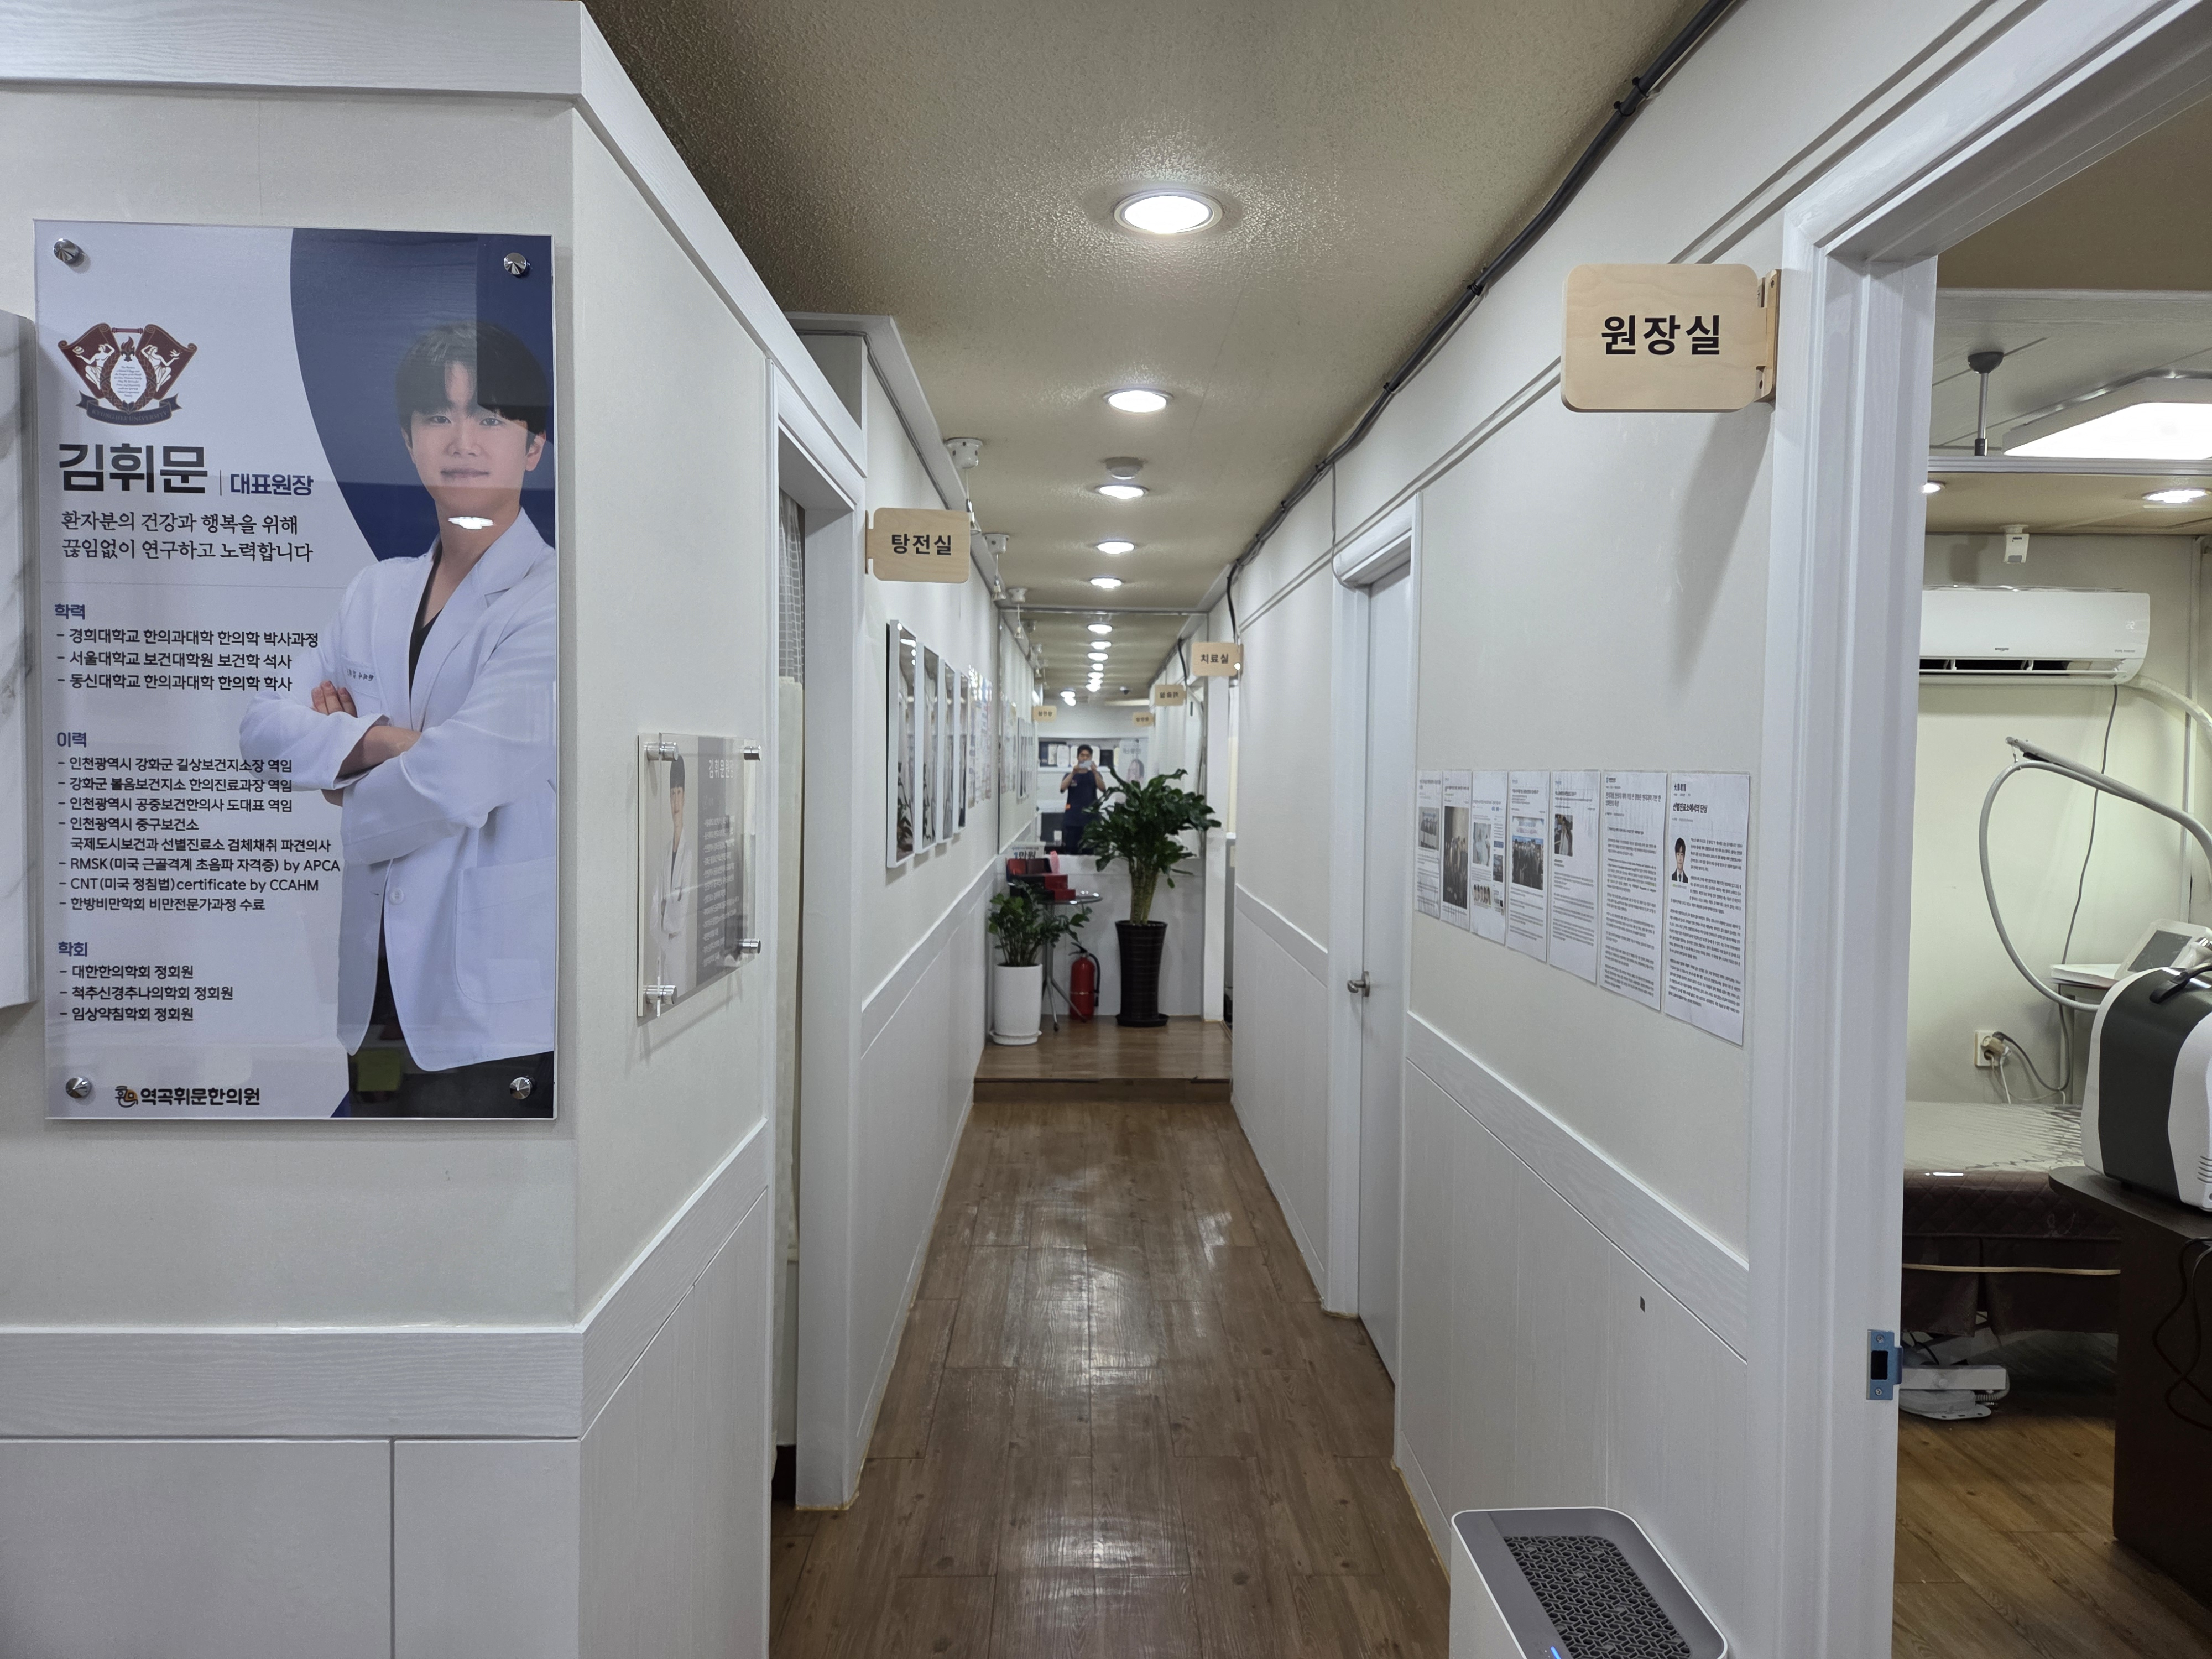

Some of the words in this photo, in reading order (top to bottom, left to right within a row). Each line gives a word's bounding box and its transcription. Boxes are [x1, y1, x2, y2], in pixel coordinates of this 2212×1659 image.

[1601, 315, 1719, 355] 원장실
[59, 443, 207, 493] 김휘문
[231, 474, 314, 495] 대표원장
[61, 510, 134, 531] 환자분의
[142, 513, 197, 533] 건강과
[201, 514, 257, 534] 행복을
[262, 515, 297, 535] 위해
[62, 539, 134, 559] 끊임없이
[142, 540, 216, 560] 연구하고
[220, 542, 313, 562] 노력합니다
[892, 534, 951, 555] 탕전실
[55, 604, 85, 620] 학력
[70, 629, 140, 644] 경희대학교
[143, 629, 214, 645] 한의과대학
[217, 630, 260, 646] 한의학
[264, 632, 317, 648] 박사과정
[70, 651, 140, 666] 서울대학교
[144, 653, 213, 667] 보건대학원
[217, 654, 260, 669] 보건학
[263, 654, 292, 669] 석사
[1201, 654, 1228, 664] 치료실
[70, 674, 140, 688] 동신대학교
[144, 675, 215, 690] 한의과대학
[218, 676, 260, 691] 한의학
[264, 676, 292, 691] 학사
[57, 732, 86, 748] 이력
[70, 757, 131, 771] 인천광역시
[135, 758, 173, 771] 강화군
[176, 758, 264, 773] 길상보건지소장
[268, 760, 291, 773] 역임
[70, 778, 107, 791] 강화군
[189, 778, 266, 792] 한의진료과장
[268, 780, 292, 792] 역임
[70, 797, 131, 811] 인천광역시
[135, 799, 225, 812] 공중보건한의사
[227, 799, 265, 812] 도대표
[268, 800, 291, 812] 역임
[70, 817, 132, 831] 인천광역시
[135, 818, 199, 831] 중구보건소
[70, 838, 159, 851] 국제도시보건과
[161, 838, 225, 851] 선별진료소
[228, 839, 276, 852] 검체채취
[281, 839, 331, 852] 파견의사
[71, 858, 139, 871] RMSK(미국
[142, 858, 191, 871] 근골격계
[196, 858, 234, 872] 초음파
[237, 859, 279, 872] 자격증)
[284, 859, 300, 873] by
[304, 860, 340, 871] APCA
[71, 878, 130, 890] CNT(미국
[250, 879, 267, 893] by
[270, 879, 318, 891] CCAHM
[71, 897, 144, 911] 한방비만학회
[150, 898, 236, 911] 비만전문가과정
[239, 899, 265, 911] 수료
[58, 942, 87, 957] 학회
[72, 965, 150, 979] 대한한의학회
[154, 966, 193, 979] 정회원
[72, 986, 189, 1000] 척추신경추나의학회
[194, 987, 233, 1000] 정회원
[72, 1007, 150, 1021] 임상약침학회
[154, 1008, 193, 1022] 정회원
[140, 1087, 260, 1105] 역곡휘문한의원
